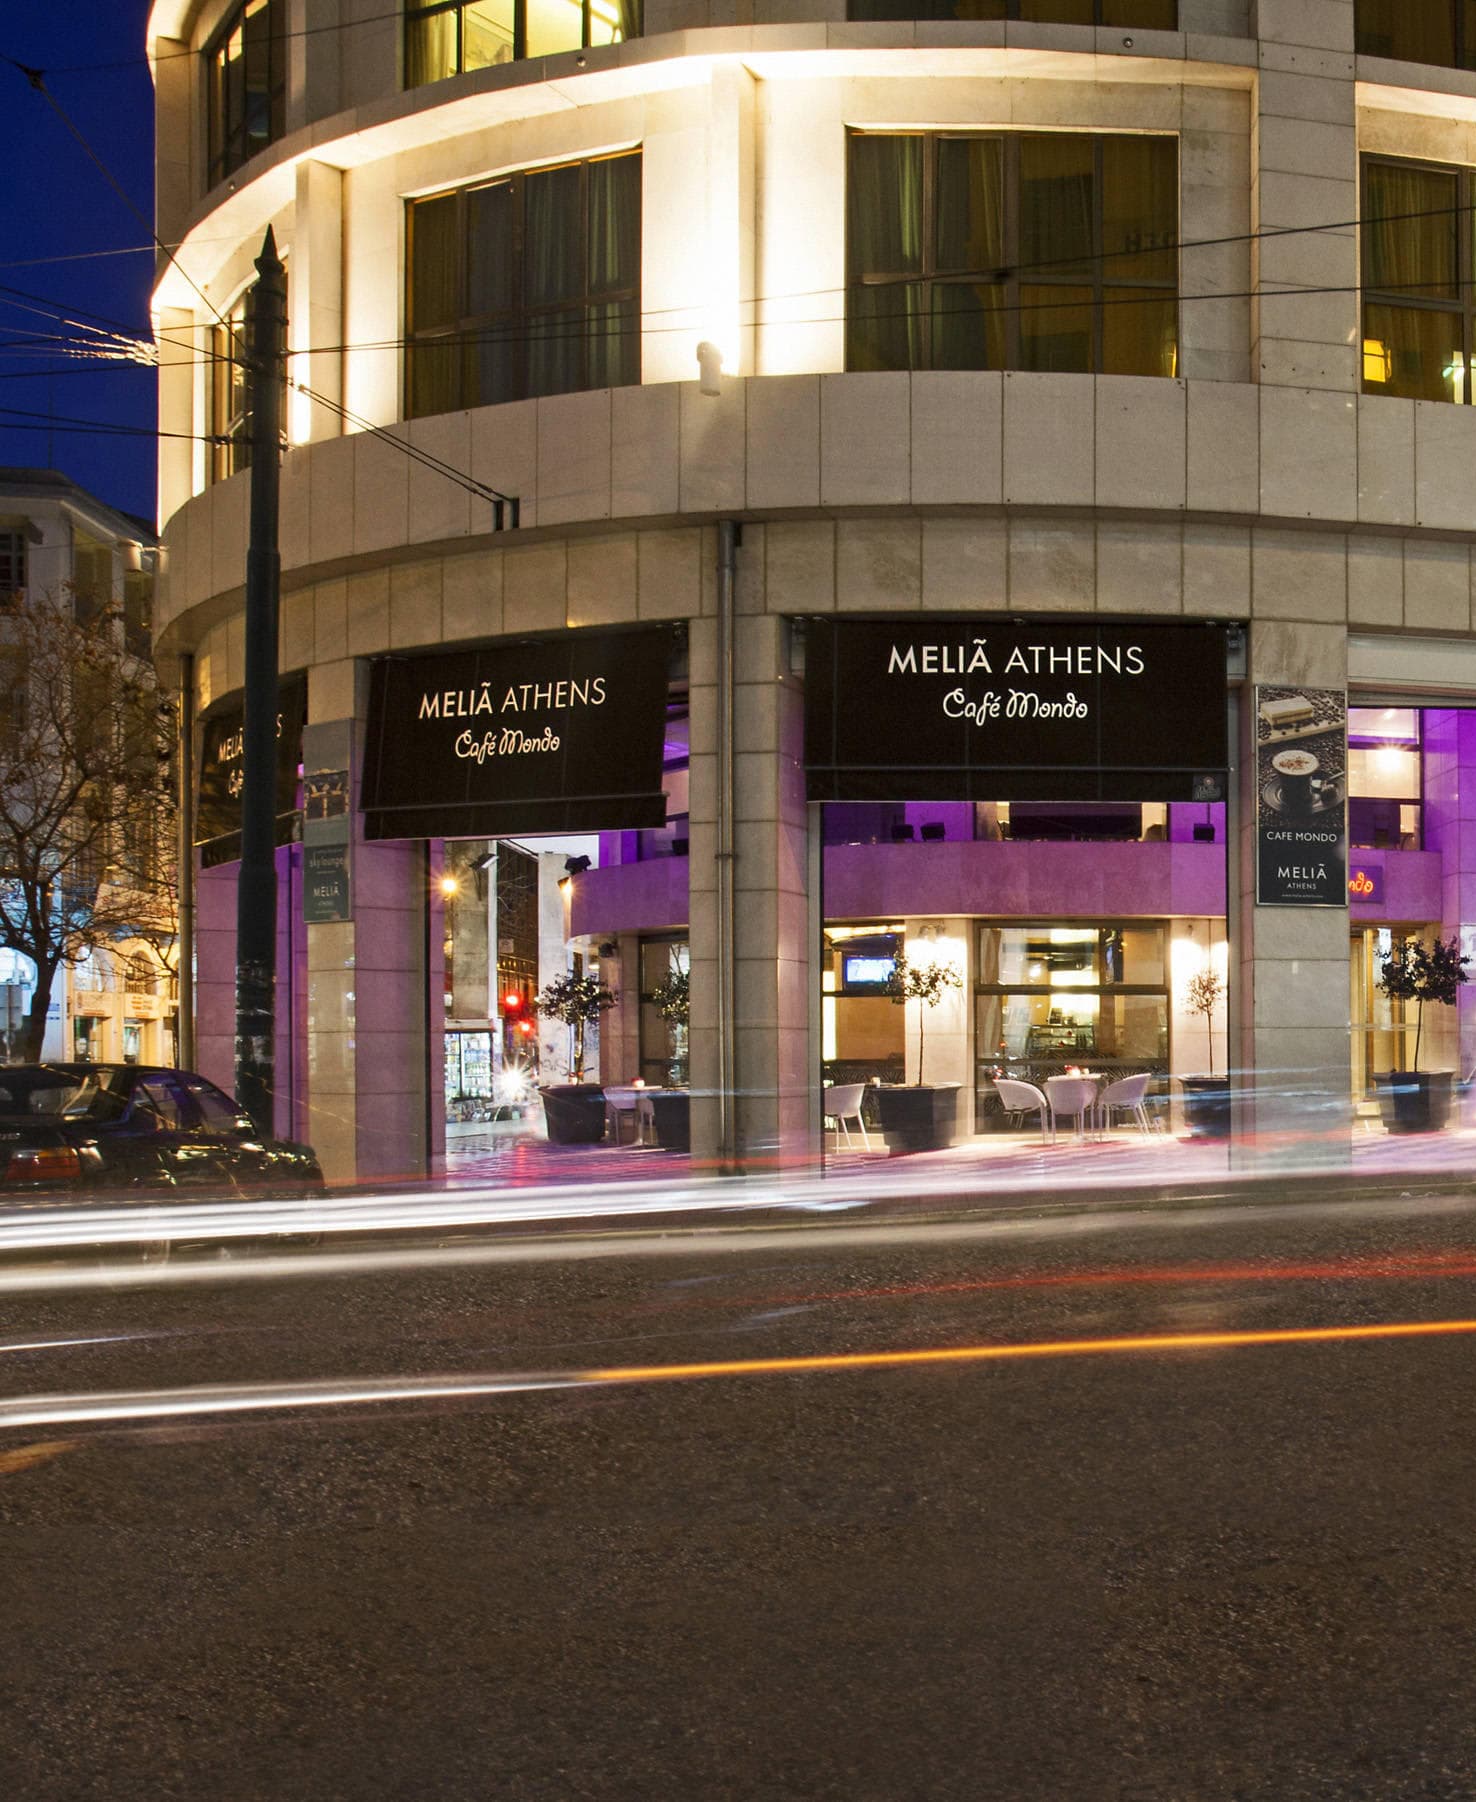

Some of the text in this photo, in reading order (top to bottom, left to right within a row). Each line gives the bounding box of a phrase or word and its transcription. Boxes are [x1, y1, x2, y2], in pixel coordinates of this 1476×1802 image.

[887, 638, 1145, 675] MELIÃ ATHENS
[418, 677, 606, 719] MELIÃ ATHENS
[942, 687, 1089, 726] Café Mondo
[454, 726, 560, 765] Café Mondo
[1266, 831, 1338, 843] CAFE MONDO
[1277, 863, 1328, 880] MELIÃ
[1286, 882, 1317, 890] ATHENS
